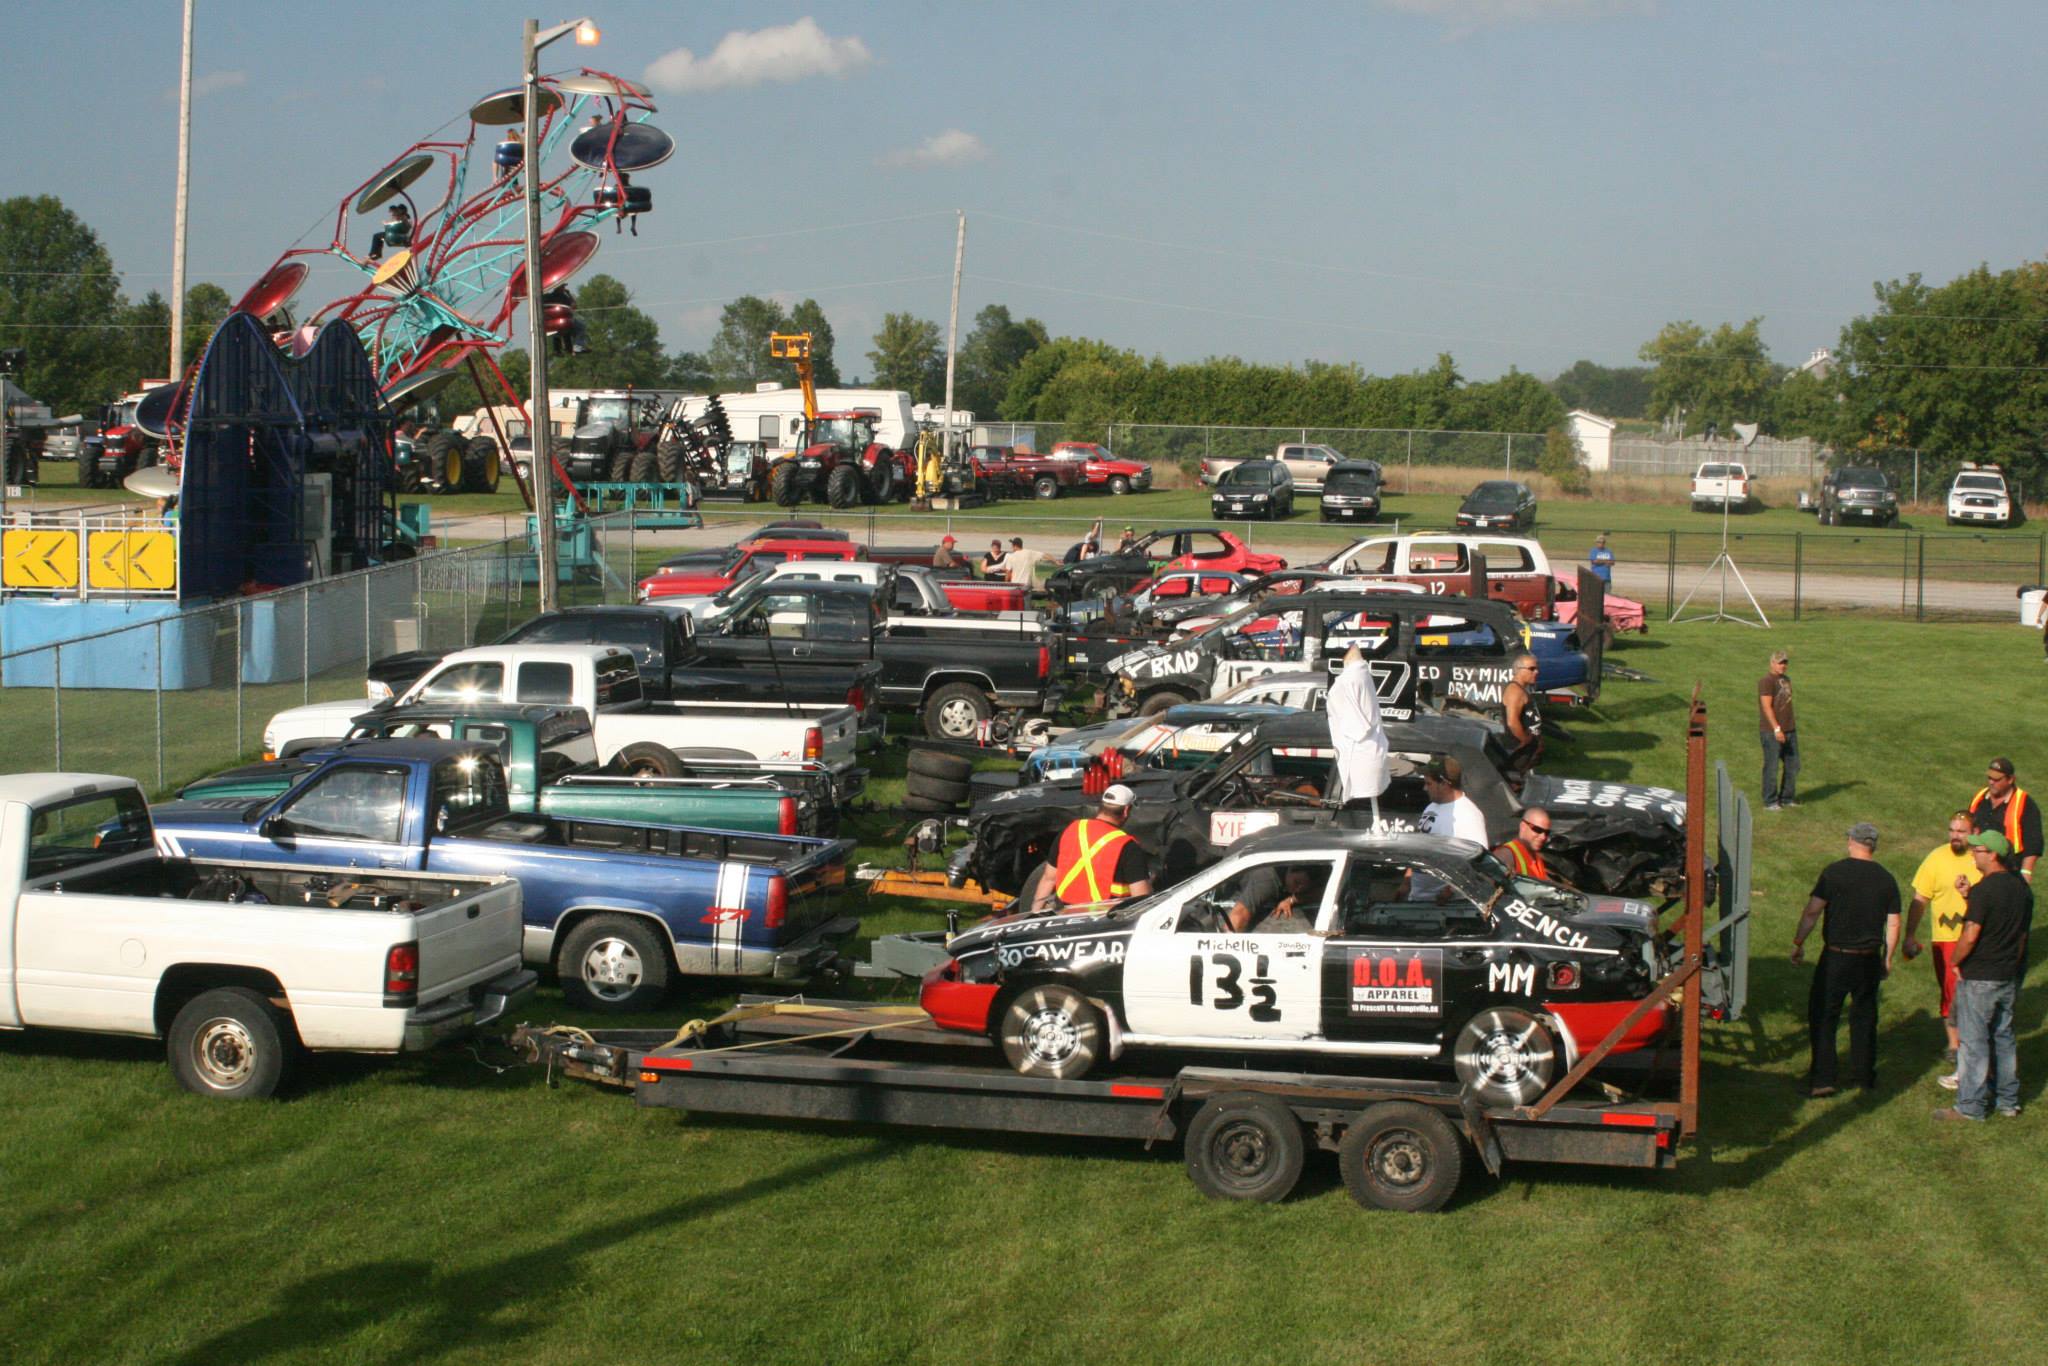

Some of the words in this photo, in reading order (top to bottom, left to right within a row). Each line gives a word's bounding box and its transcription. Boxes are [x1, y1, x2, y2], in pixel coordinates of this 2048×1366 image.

[1430, 582, 1446, 595] 12
[1150, 650, 1199, 678] BRAD
[1453, 666, 1474, 681] BY
[980, 916, 1101, 938] HURLEY
[1504, 899, 1588, 949] BENCH
[998, 940, 1126, 967] ROCAWEAR
[1198, 938, 1260, 954] Michelle
[1353, 956, 1432, 987] D.O.A.
[1489, 962, 1535, 997] MM
[1367, 990, 1418, 1000] APPAREL
